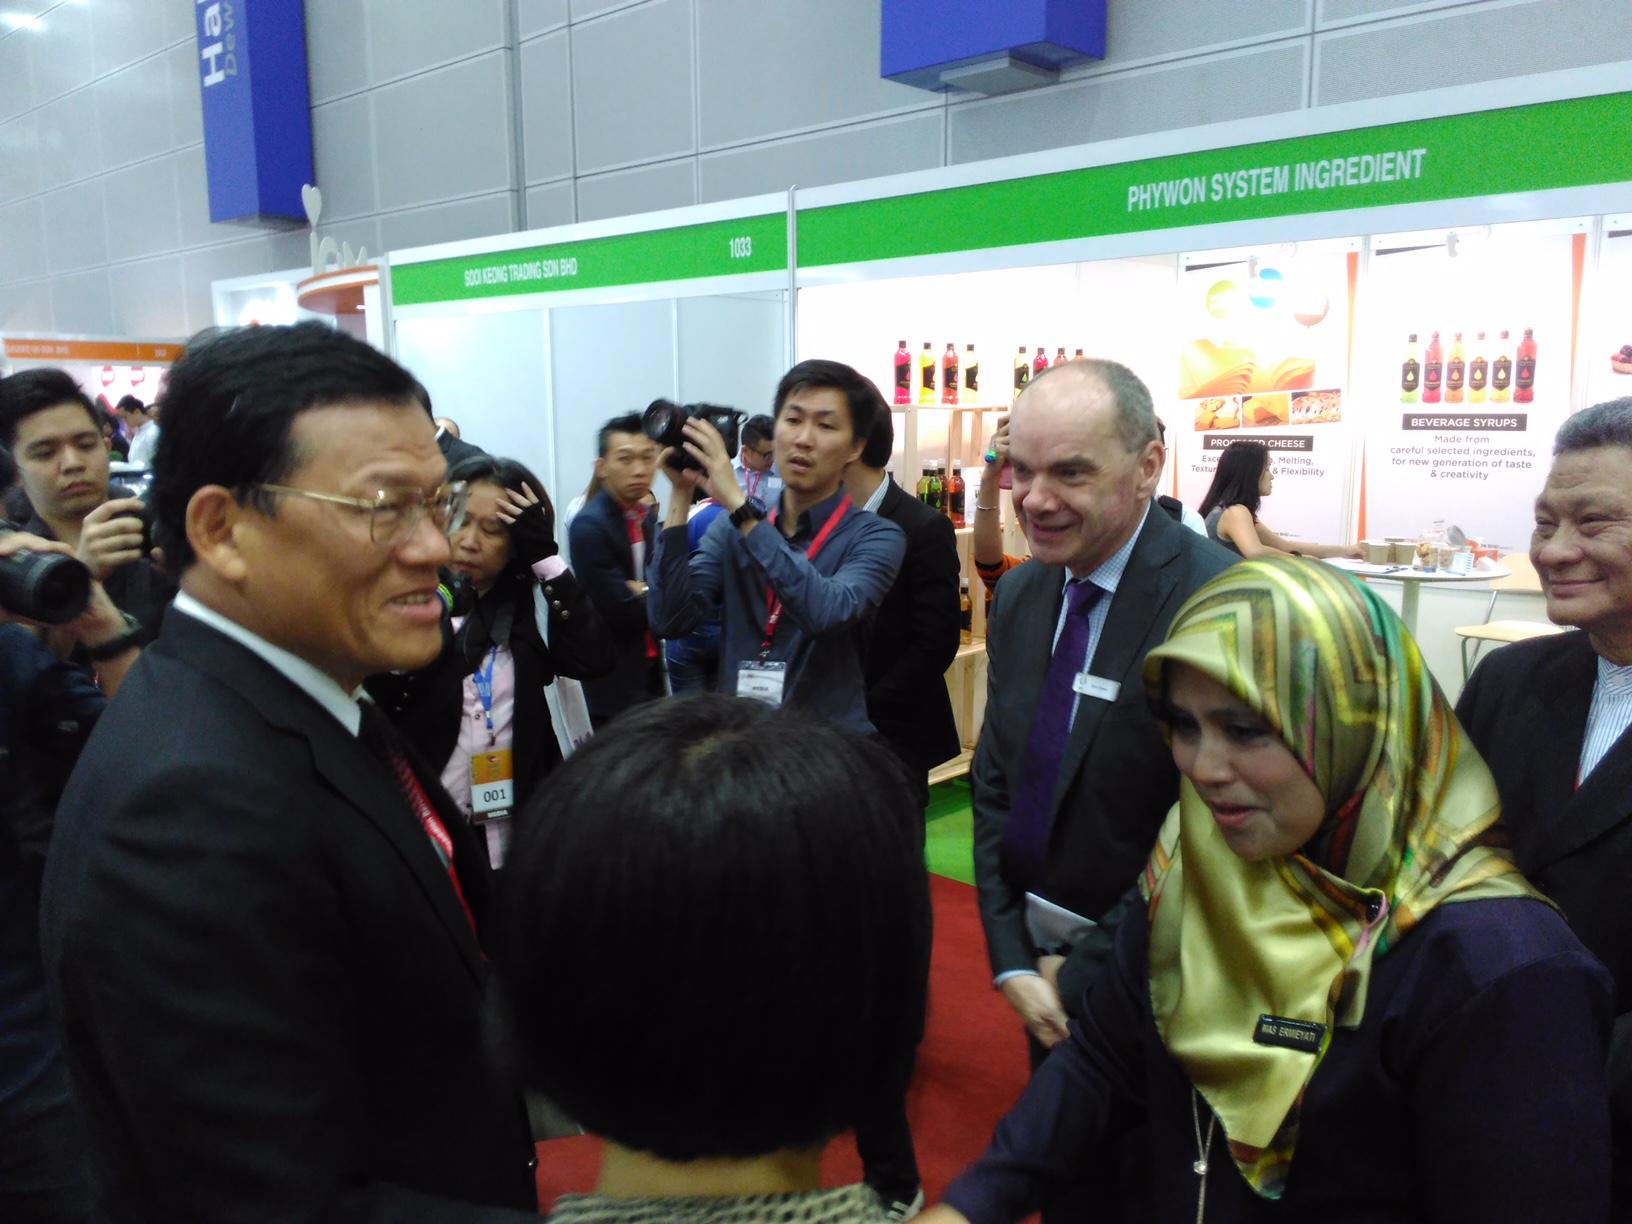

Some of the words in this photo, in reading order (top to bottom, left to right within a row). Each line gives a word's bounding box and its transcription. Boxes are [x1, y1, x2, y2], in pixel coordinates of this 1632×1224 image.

[198, 0, 226, 87] Ha
[1127, 175, 1206, 212] PHYWON
[1210, 164, 1289, 201] SYSTEM
[1293, 148, 1427, 191] INGREDIENT
[729, 236, 752, 258] 1033
[482, 265, 508, 284] KEONG
[508, 260, 542, 282] TRADING
[543, 258, 560, 278] SDN
[560, 257, 578, 276] BHD
[1411, 418, 1471, 427] BEVERAGE
[1473, 418, 1518, 428] SYRUPS
[1267, 439, 1306, 449] CHEESE
[1434, 435, 1462, 444] Made
[1465, 435, 1490, 444] from
[1390, 446, 1424, 455] careful
[1427, 447, 1470, 456] selected
[1473, 447, 1536, 458] ingredients,
[1392, 457, 1406, 466] for
[1409, 459, 1430, 467] new
[1432, 458, 1489, 468] generation
[1491, 459, 1503, 468] of
[1505, 460, 1532, 469] taste
[1272, 466, 1279, 475] &
[1281, 467, 1325, 478] Flexibility
[1430, 470, 1437, 478] &
[1440, 470, 1489, 480] creativity
[483, 788, 507, 803] 001
